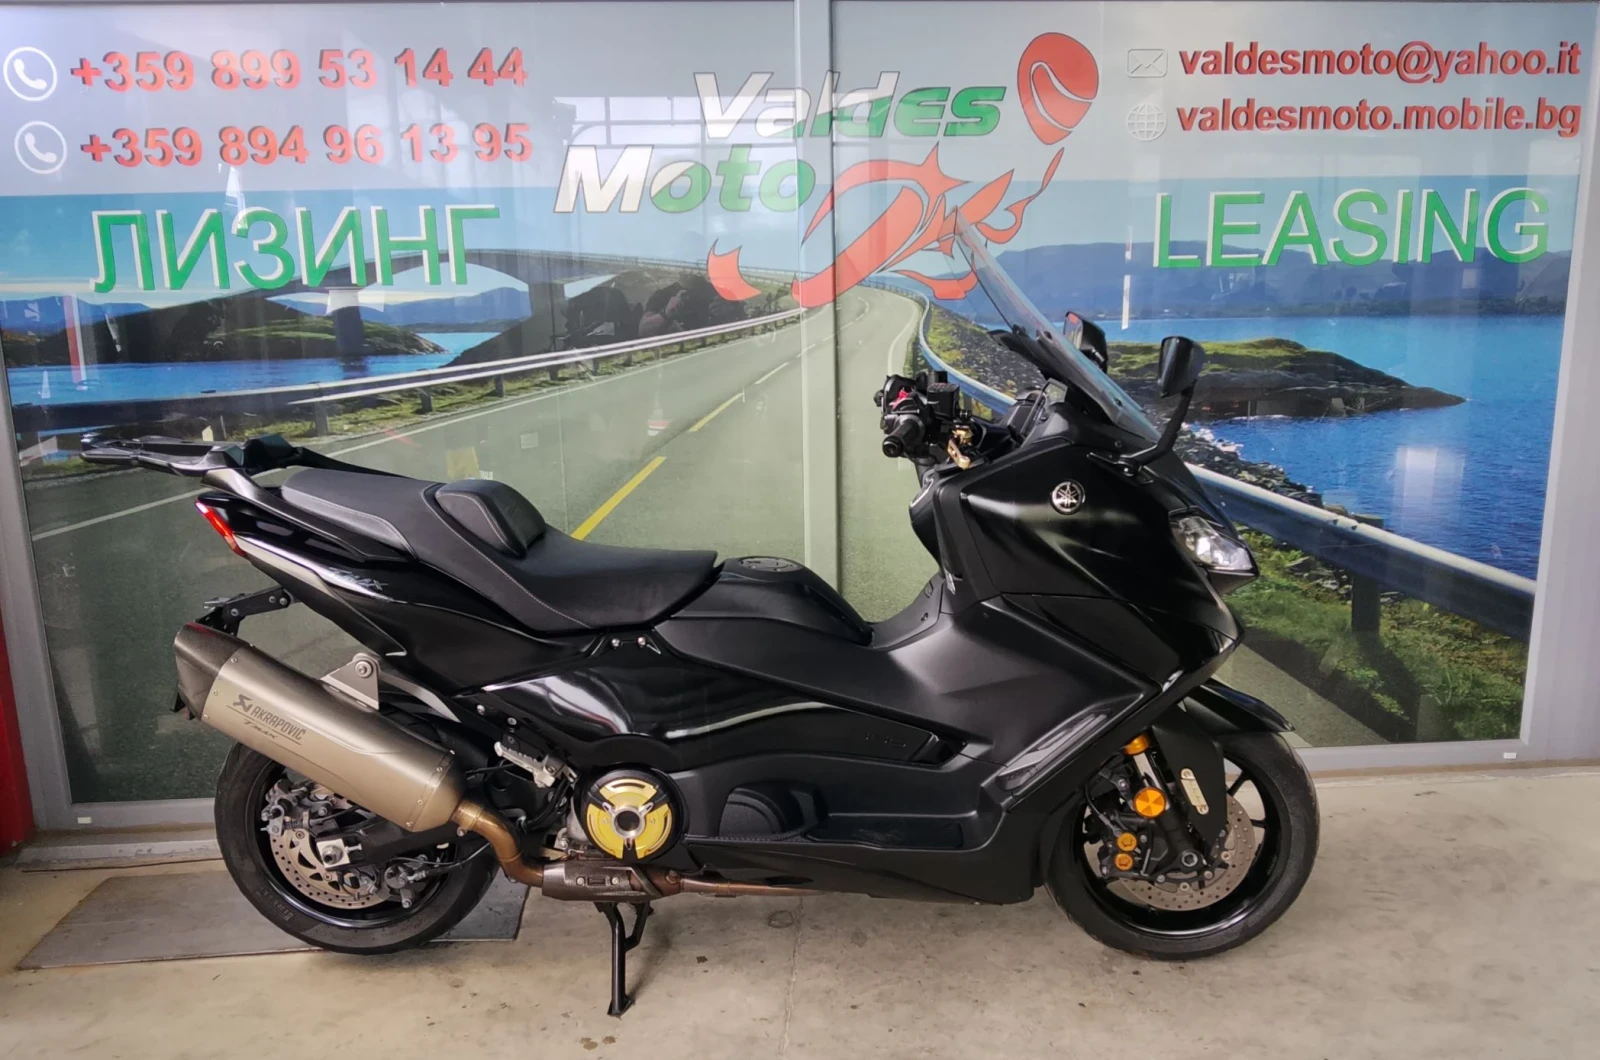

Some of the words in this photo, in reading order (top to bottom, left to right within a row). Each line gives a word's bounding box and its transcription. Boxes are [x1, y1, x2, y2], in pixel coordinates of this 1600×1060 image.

[71, 50, 195, 92] +359
[211, 49, 301, 91] 899
[319, 48, 377, 89] 53
[394, 47, 454, 87] 14
[467, 47, 529, 87] 44
[1178, 41, 1581, 84] valdesmoto@yahoo.it
[693, 71, 1006, 140] Valdes
[1176, 97, 1582, 139] valdesmoto.mobile.bg
[81, 127, 203, 168] +359
[218, 125, 310, 166] 894
[323, 124, 384, 164] 96
[402, 123, 457, 163] 13
[473, 122, 532, 162] 95
[553, 144, 816, 214] Moto
[91, 204, 500, 293] ЛИЗИНГ
[1153, 187, 1549, 268] LEASING
